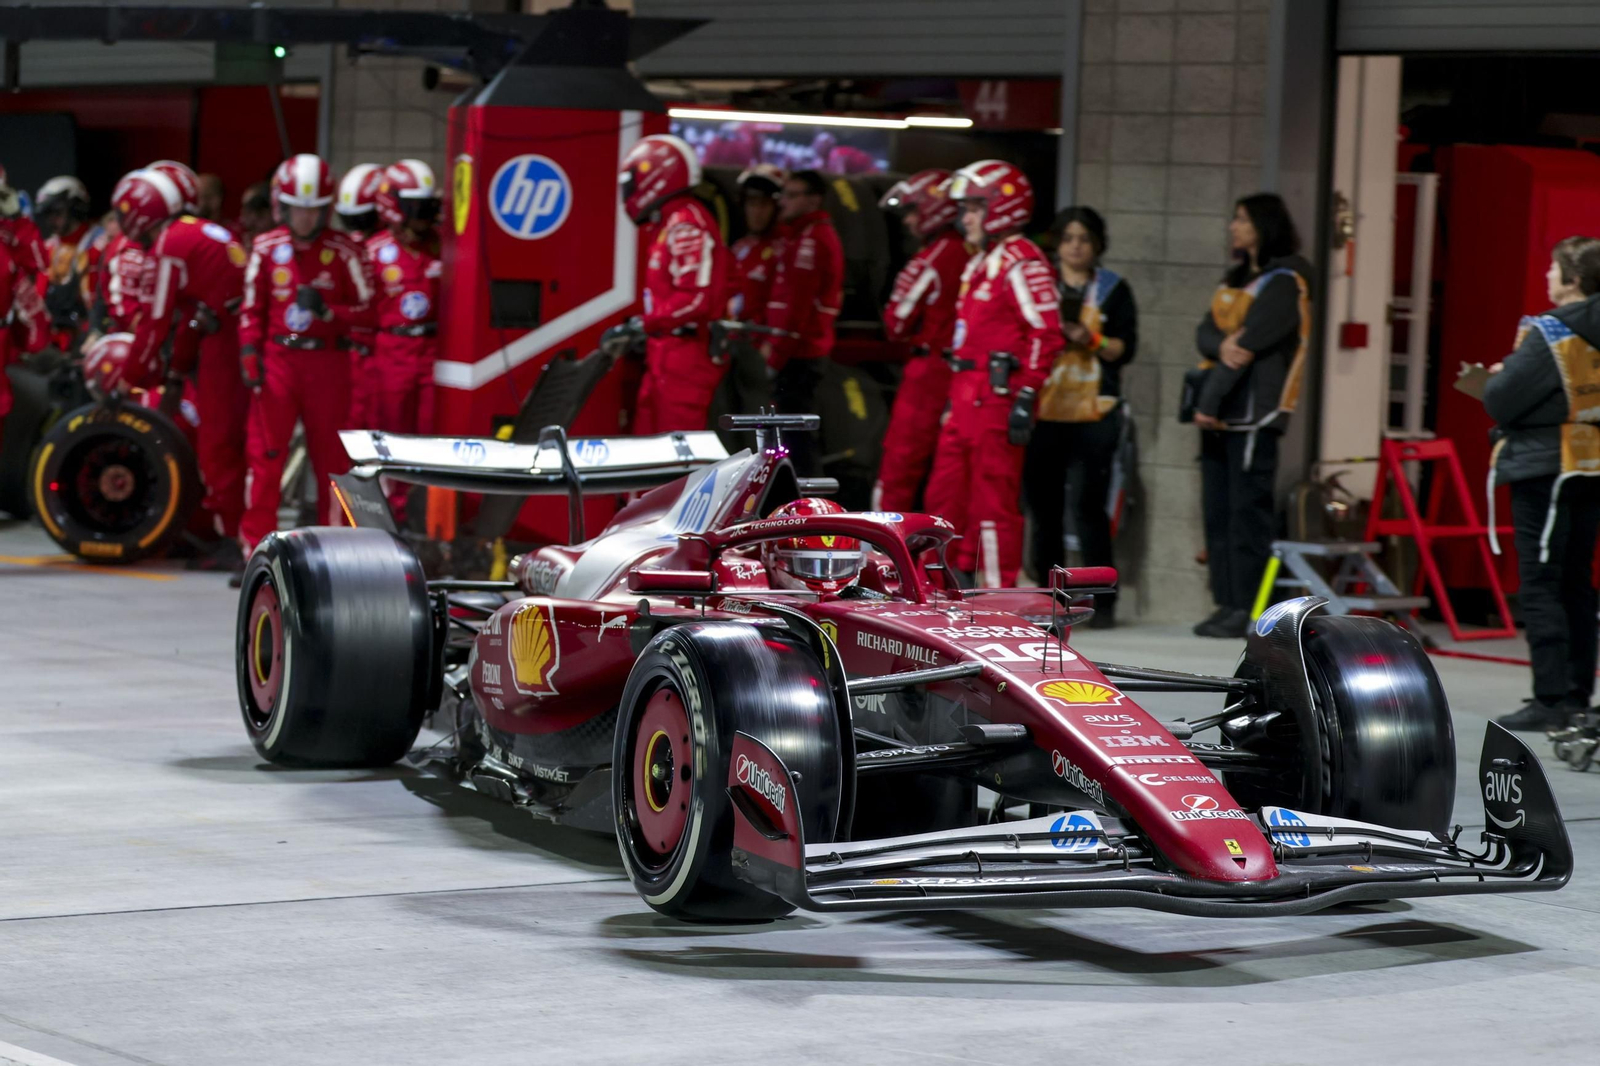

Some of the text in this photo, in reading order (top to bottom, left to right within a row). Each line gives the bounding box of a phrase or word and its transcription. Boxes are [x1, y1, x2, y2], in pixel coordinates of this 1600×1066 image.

[974, 79, 1008, 120] 44
[502, 156, 560, 237] hp
[457, 440, 484, 465] hp
[578, 440, 607, 465] hp
[750, 517, 808, 530] TECHNOLOGY
[730, 564, 766, 579] Ray-Ban
[925, 625, 1047, 635] GLOBAL
[946, 630, 1052, 639] POKER
[857, 631, 940, 666] RICHARD MILLE
[973, 642, 1079, 662] 16
[1082, 714, 1135, 724] aws
[1098, 735, 1171, 748] IBM
[1111, 755, 1196, 764] PIRELLI
[749, 761, 786, 814] UniCredit
[1062, 757, 1105, 807] UniCredit
[1485, 771, 1523, 804] aws
[1053, 815, 1097, 852] hp
[1274, 809, 1304, 847] hp
[905, 876, 1037, 885] V-Power
